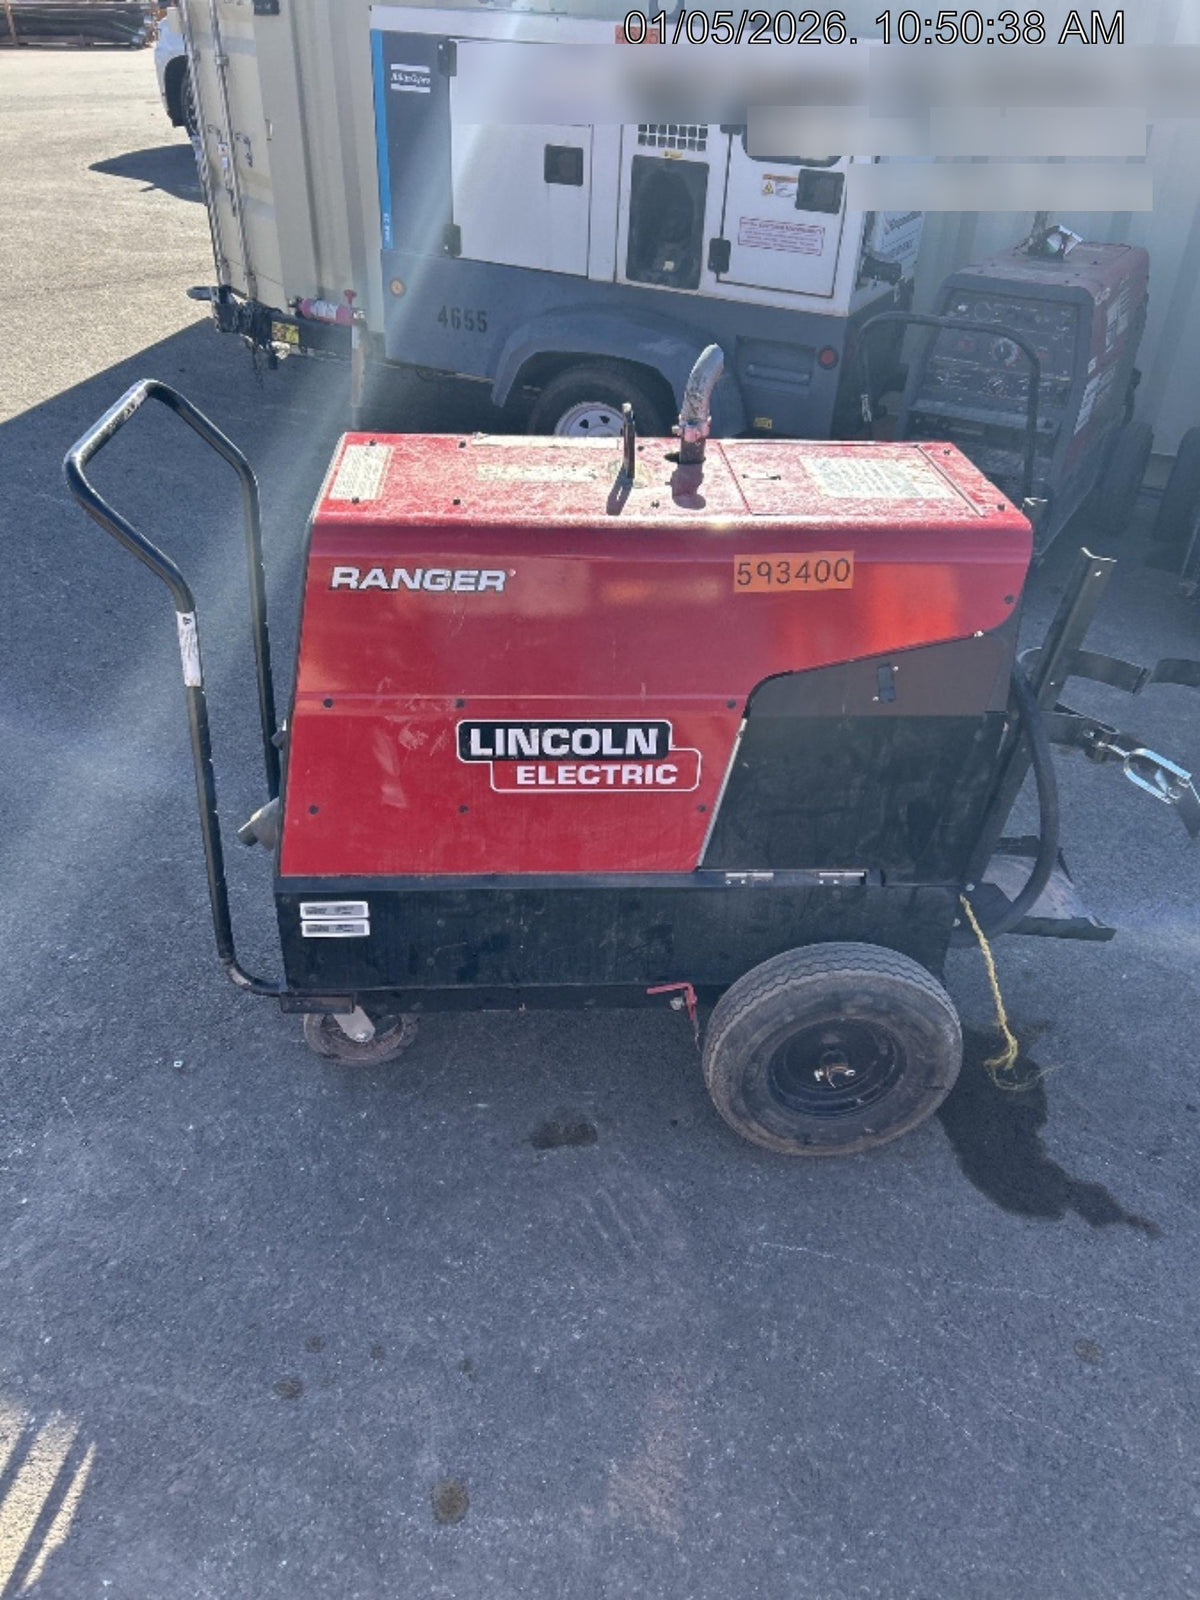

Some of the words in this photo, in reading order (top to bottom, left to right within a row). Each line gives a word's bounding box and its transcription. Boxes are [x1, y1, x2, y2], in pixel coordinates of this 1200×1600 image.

[437, 304, 488, 333] 4655
[329, 565, 507, 592] RANGER
[736, 557, 851, 586] 593400
[470, 728, 659, 757] LINCOLN
[516, 764, 678, 785] ELECTRIC
